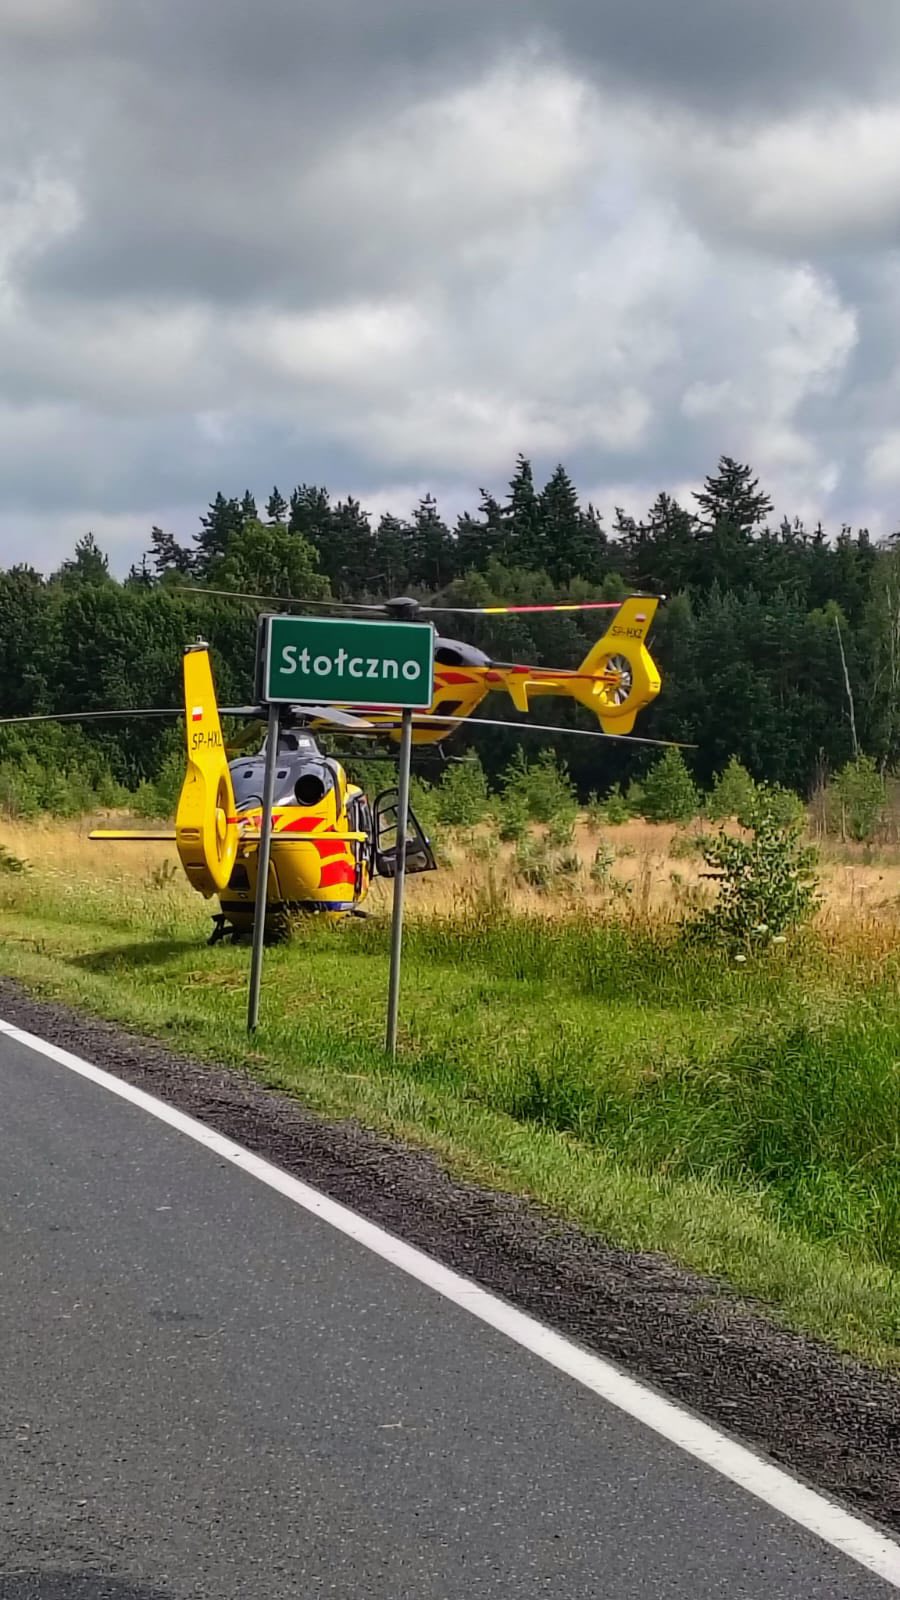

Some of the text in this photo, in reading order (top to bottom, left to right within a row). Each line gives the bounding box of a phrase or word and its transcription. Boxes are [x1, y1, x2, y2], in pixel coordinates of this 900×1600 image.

[611, 625, 643, 639] SP-HXZ
[279, 645, 421, 680] Stołczno
[191, 730, 222, 750] SP-HXL
